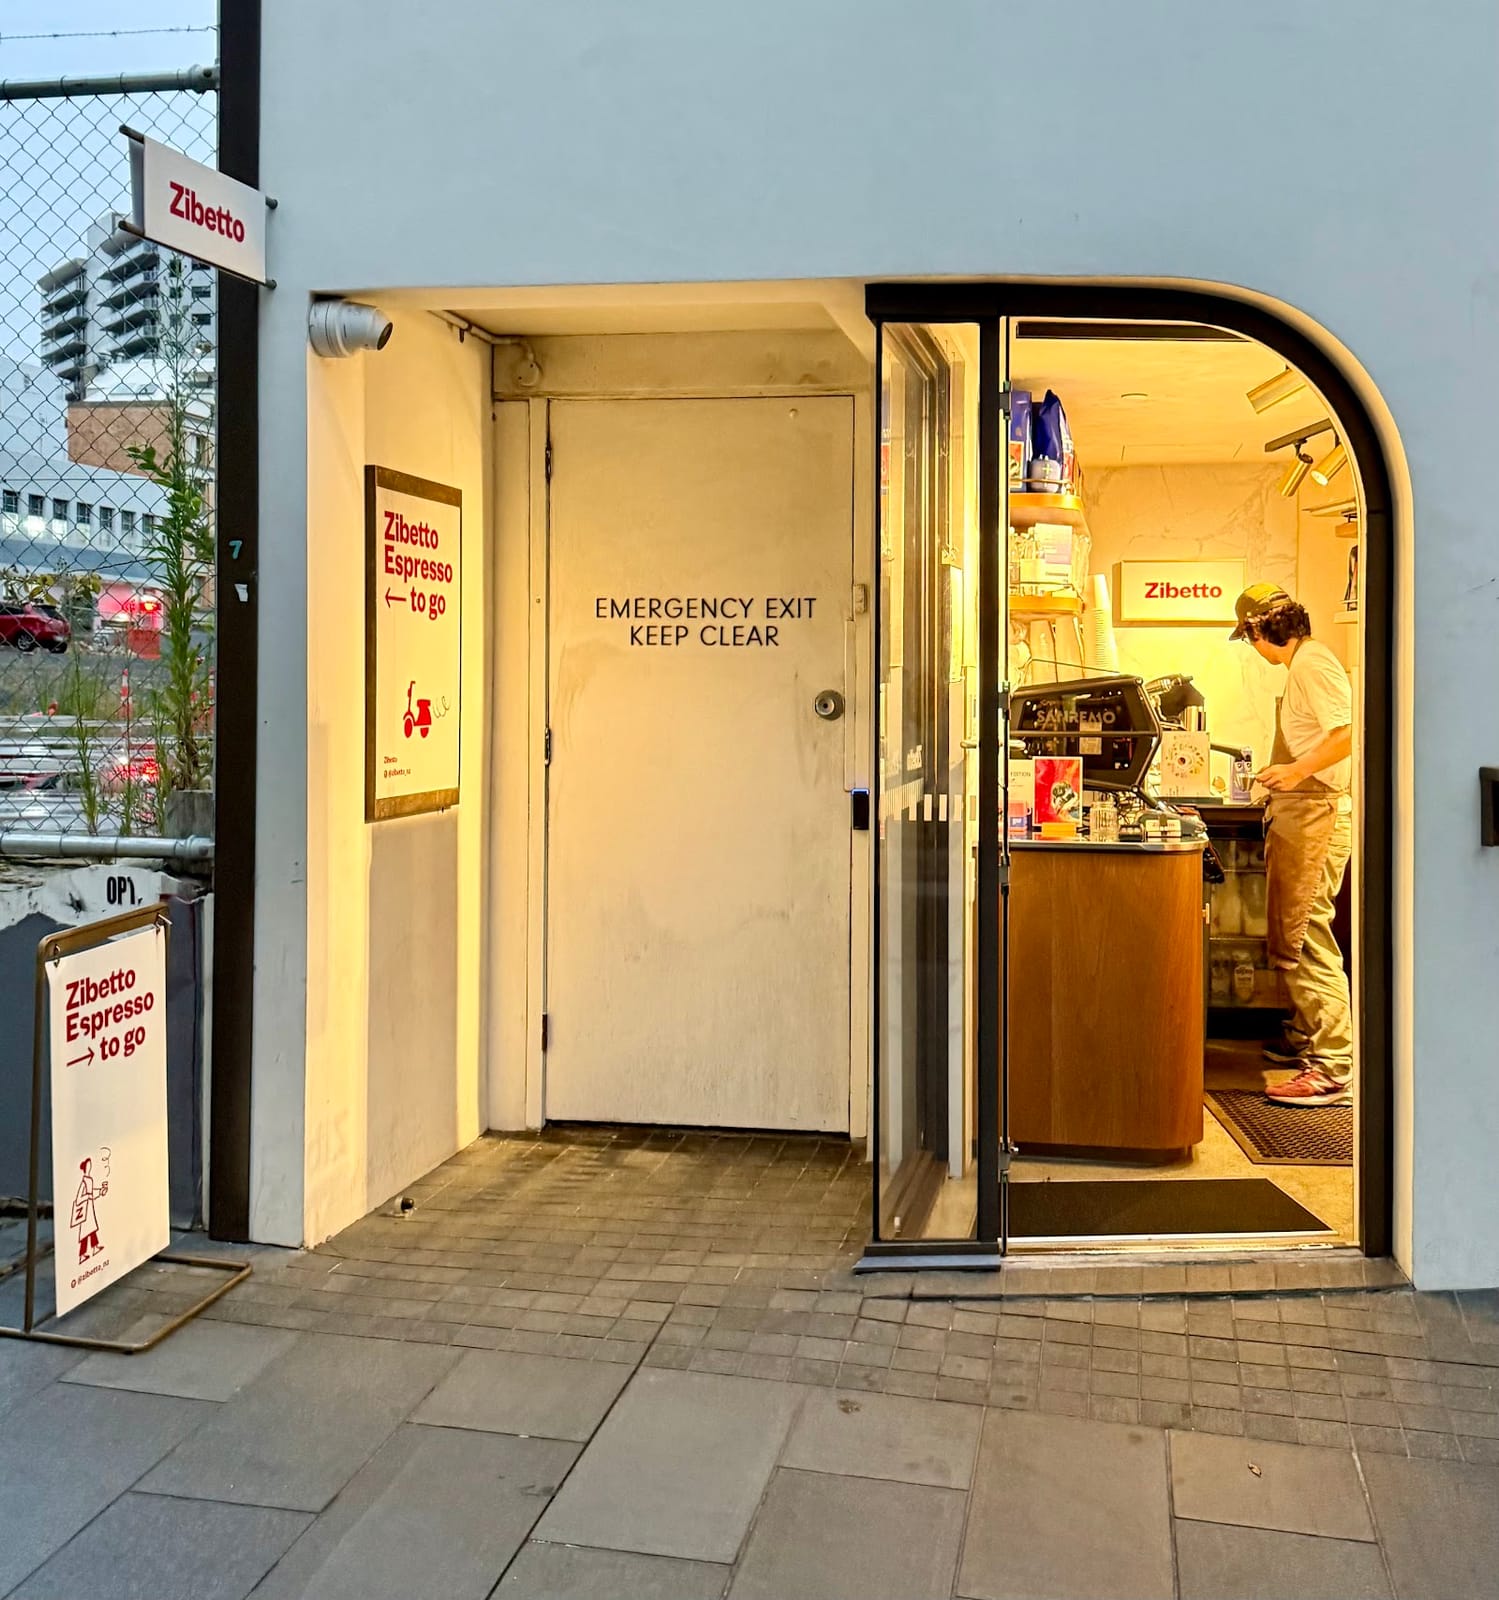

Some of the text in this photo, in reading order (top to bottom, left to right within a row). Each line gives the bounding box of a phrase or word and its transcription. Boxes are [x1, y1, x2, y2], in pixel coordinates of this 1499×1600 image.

[169, 181, 245, 243] Zibetto
[384, 510, 439, 550] Zibetto
[384, 544, 453, 583] Espresso
[410, 586, 446, 621] to go
[595, 597, 817, 619] EMERGENCY EXIT
[1144, 582, 1223, 599] Zibetto
[630, 625, 779, 647] KEEP CLEAR
[1037, 710, 1117, 725] SANREMO
[66, 968, 136, 1011] Zibetto
[66, 992, 154, 1043] Espresso
[100, 1026, 146, 1061] to go
